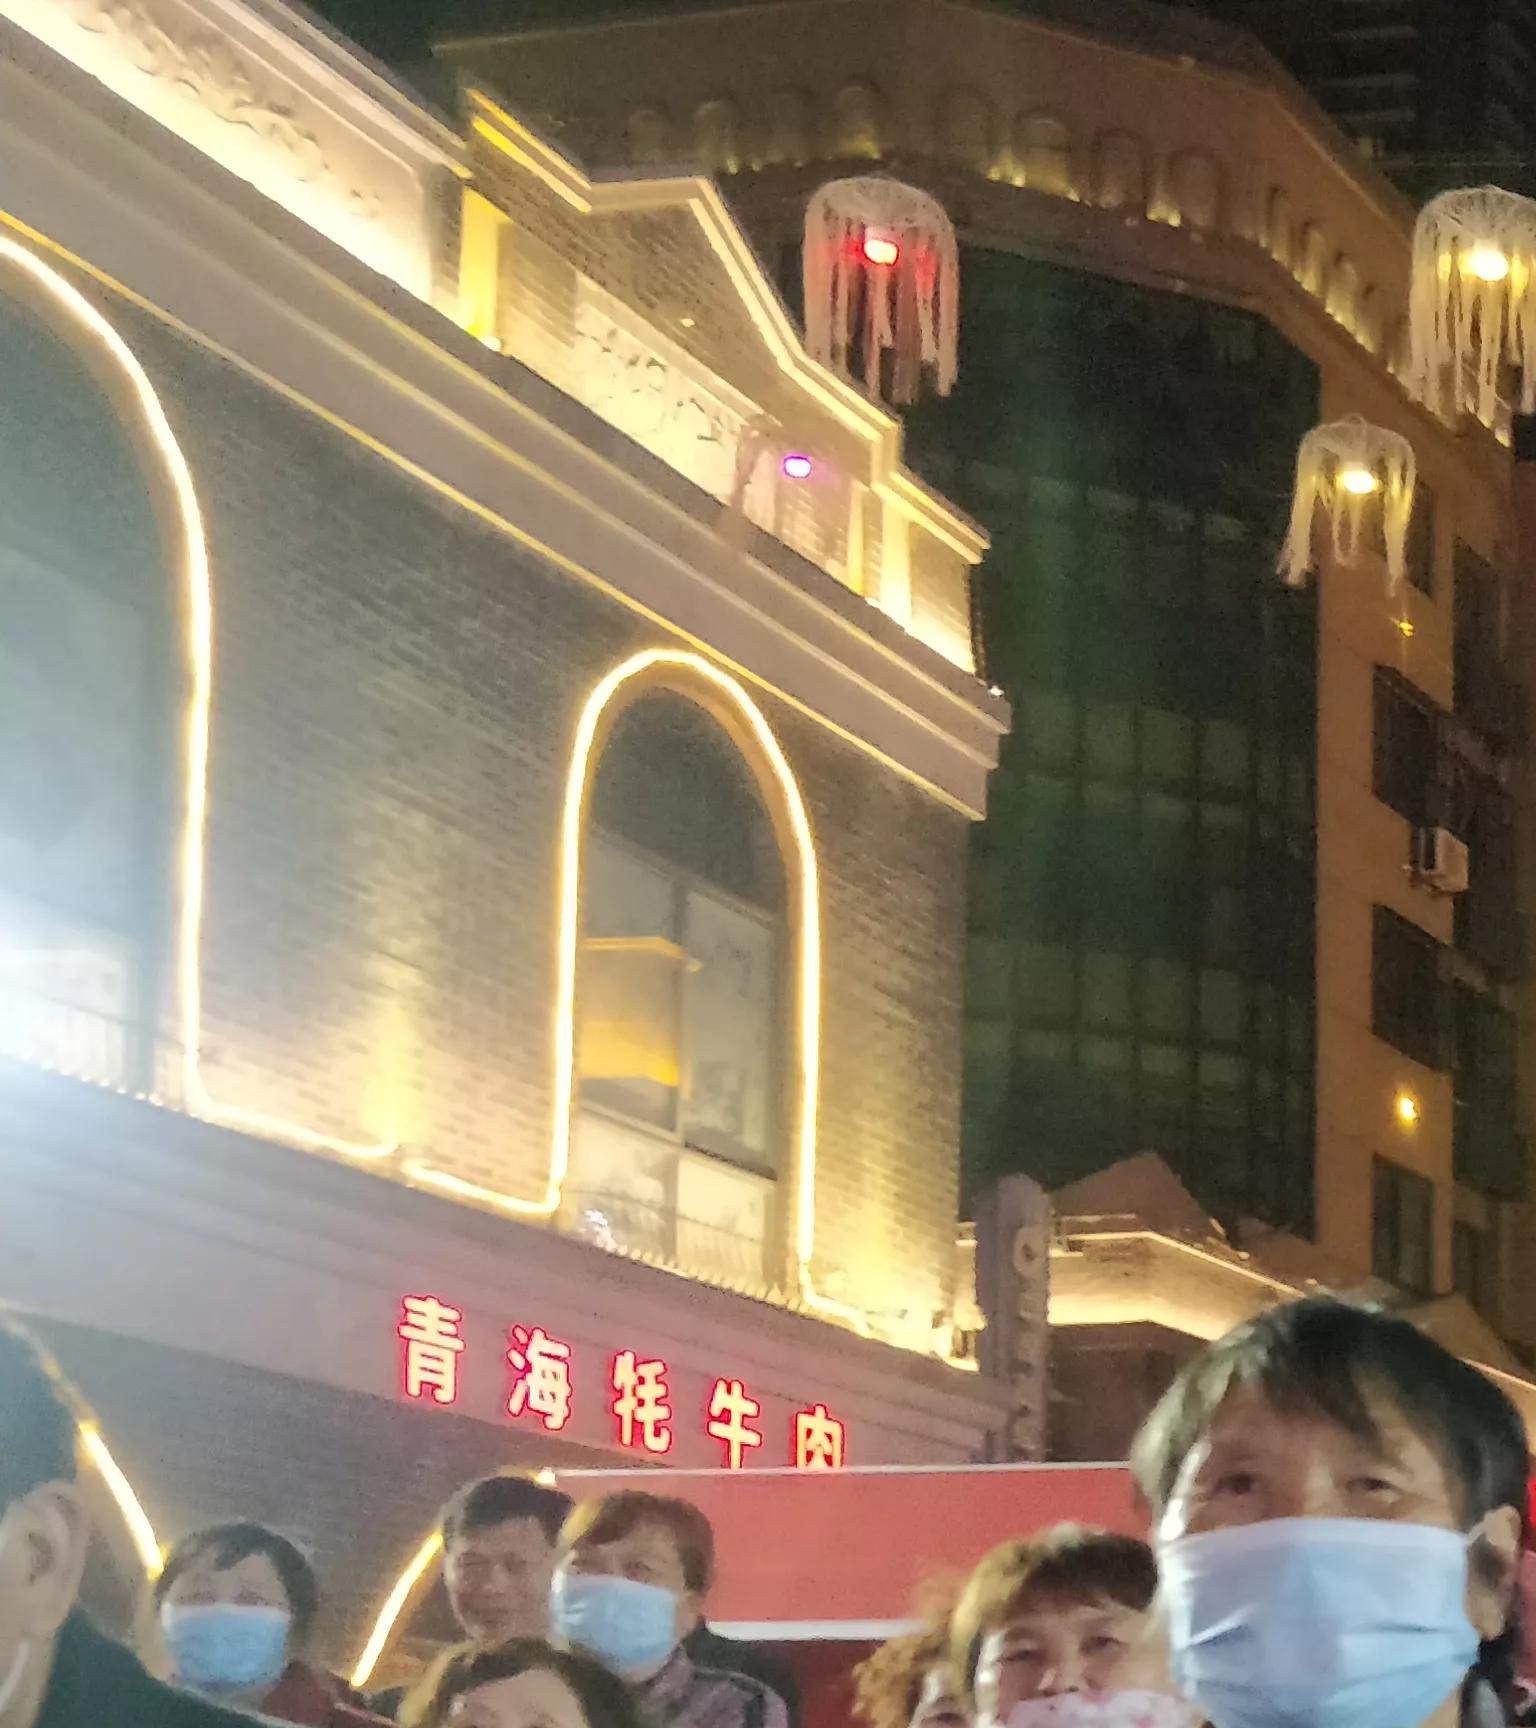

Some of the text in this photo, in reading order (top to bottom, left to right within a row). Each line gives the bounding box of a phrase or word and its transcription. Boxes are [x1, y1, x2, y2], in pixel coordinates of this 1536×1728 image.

[397, 1293, 846, 1470] 青海牦牛肉
